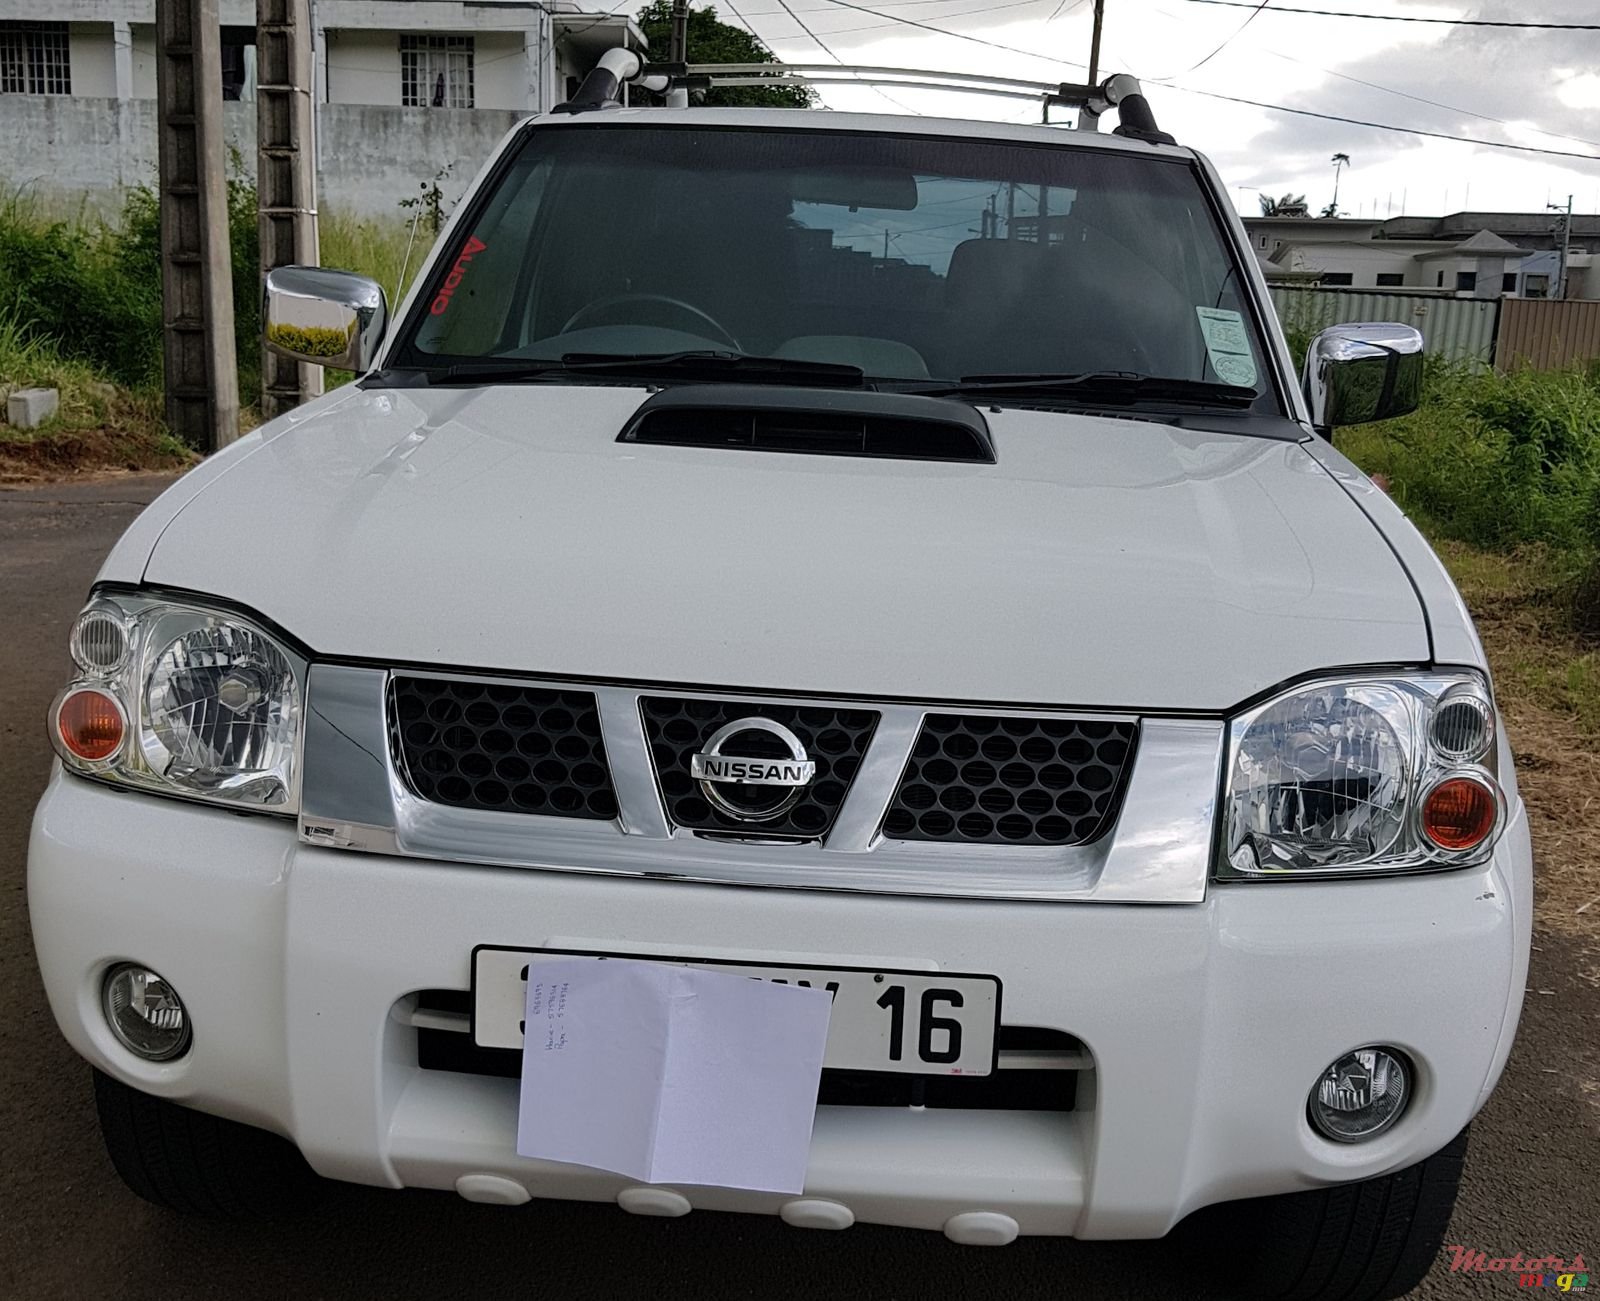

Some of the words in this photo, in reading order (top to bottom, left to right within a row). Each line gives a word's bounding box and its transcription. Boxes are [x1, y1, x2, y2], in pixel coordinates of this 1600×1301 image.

[431, 234, 487, 315] AUDIO
[704, 761, 801, 781] NISSAN
[876, 985, 964, 1064] 16
